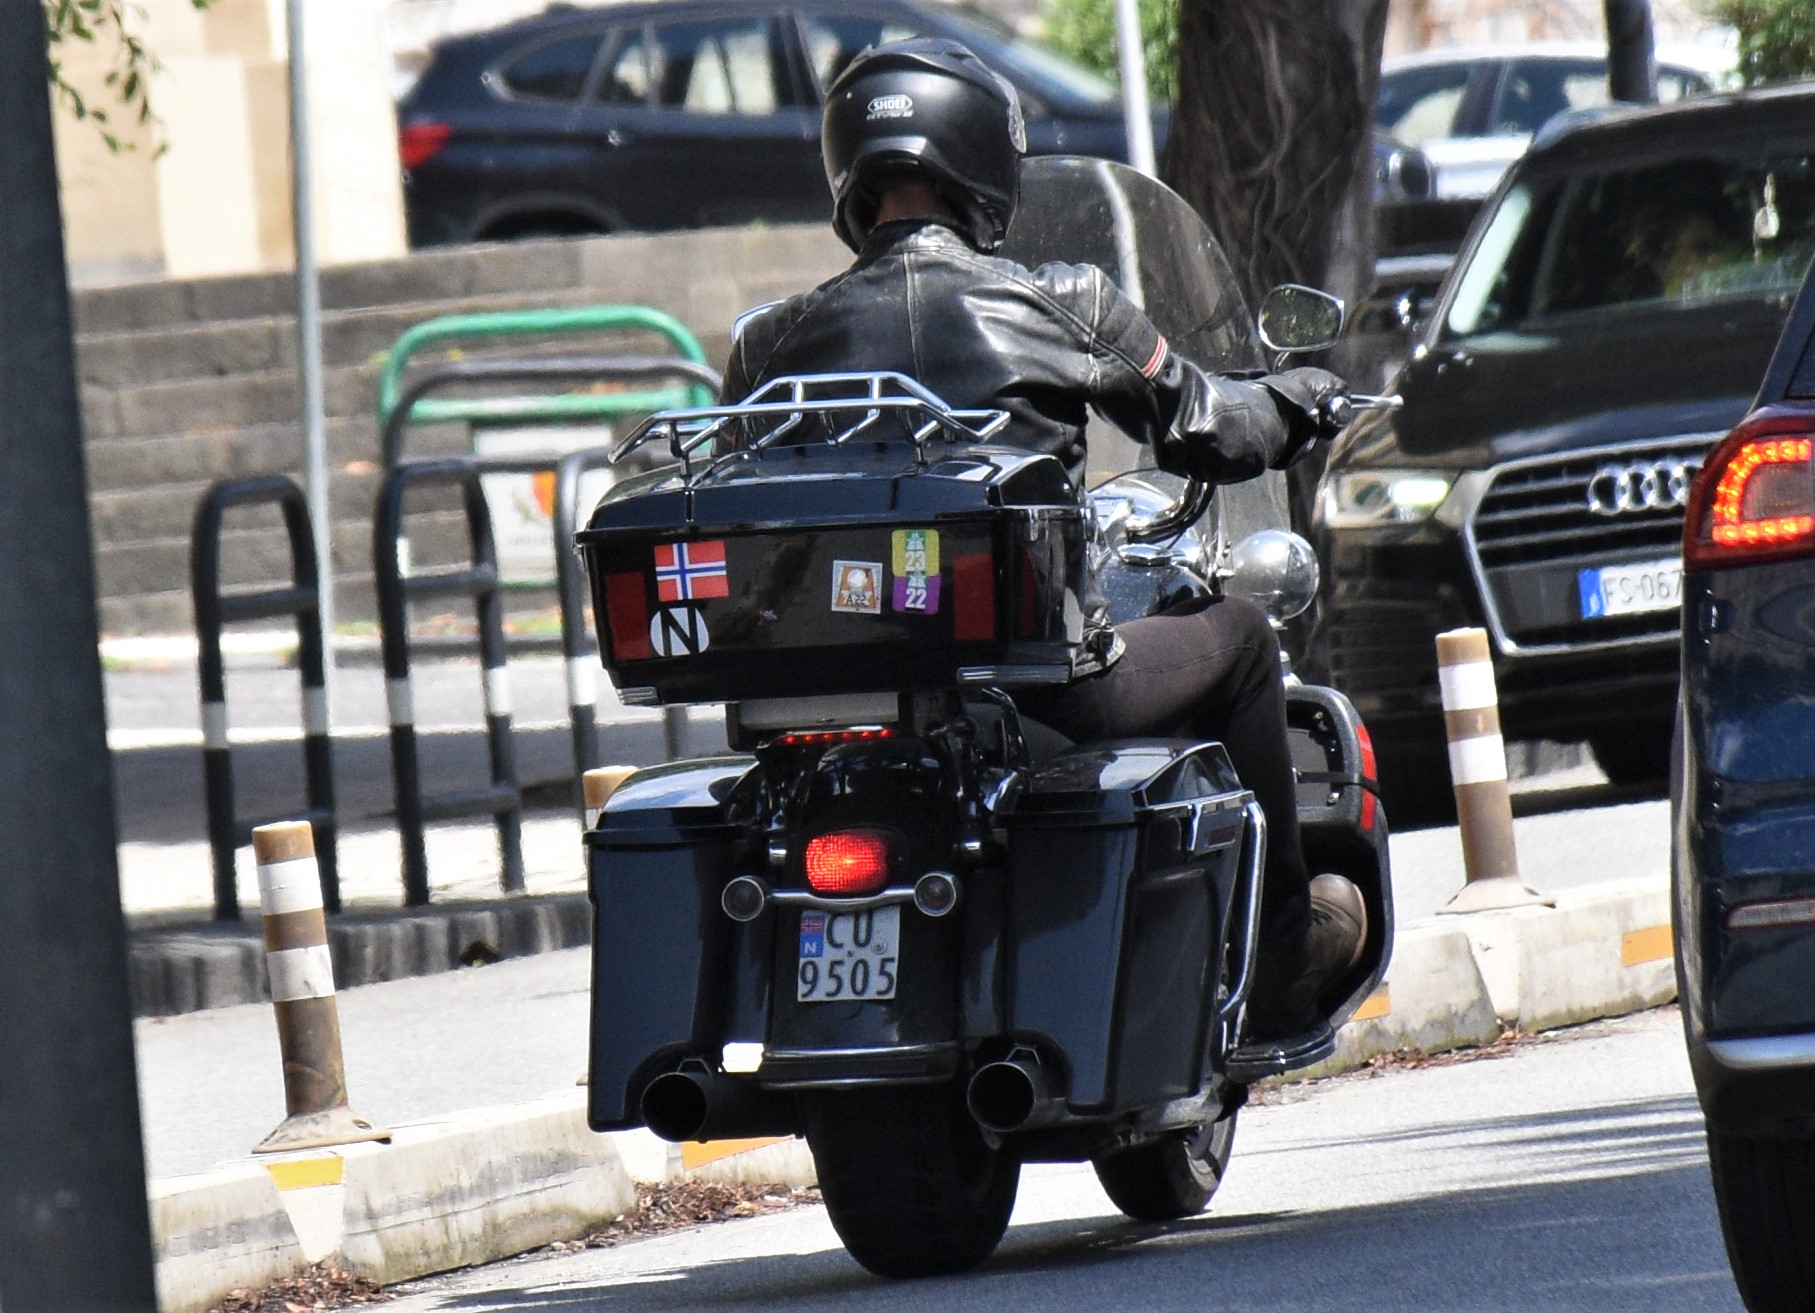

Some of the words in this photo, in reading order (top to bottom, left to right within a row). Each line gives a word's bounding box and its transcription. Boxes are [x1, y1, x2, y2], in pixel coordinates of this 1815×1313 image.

[873, 98, 906, 111] SHOEI
[905, 550, 926, 572] 23
[905, 588, 928, 609] 22
[659, 606, 701, 657] N
[826, 911, 875, 949] CU
[804, 941, 817, 955] N
[800, 957, 896, 998] 9505
